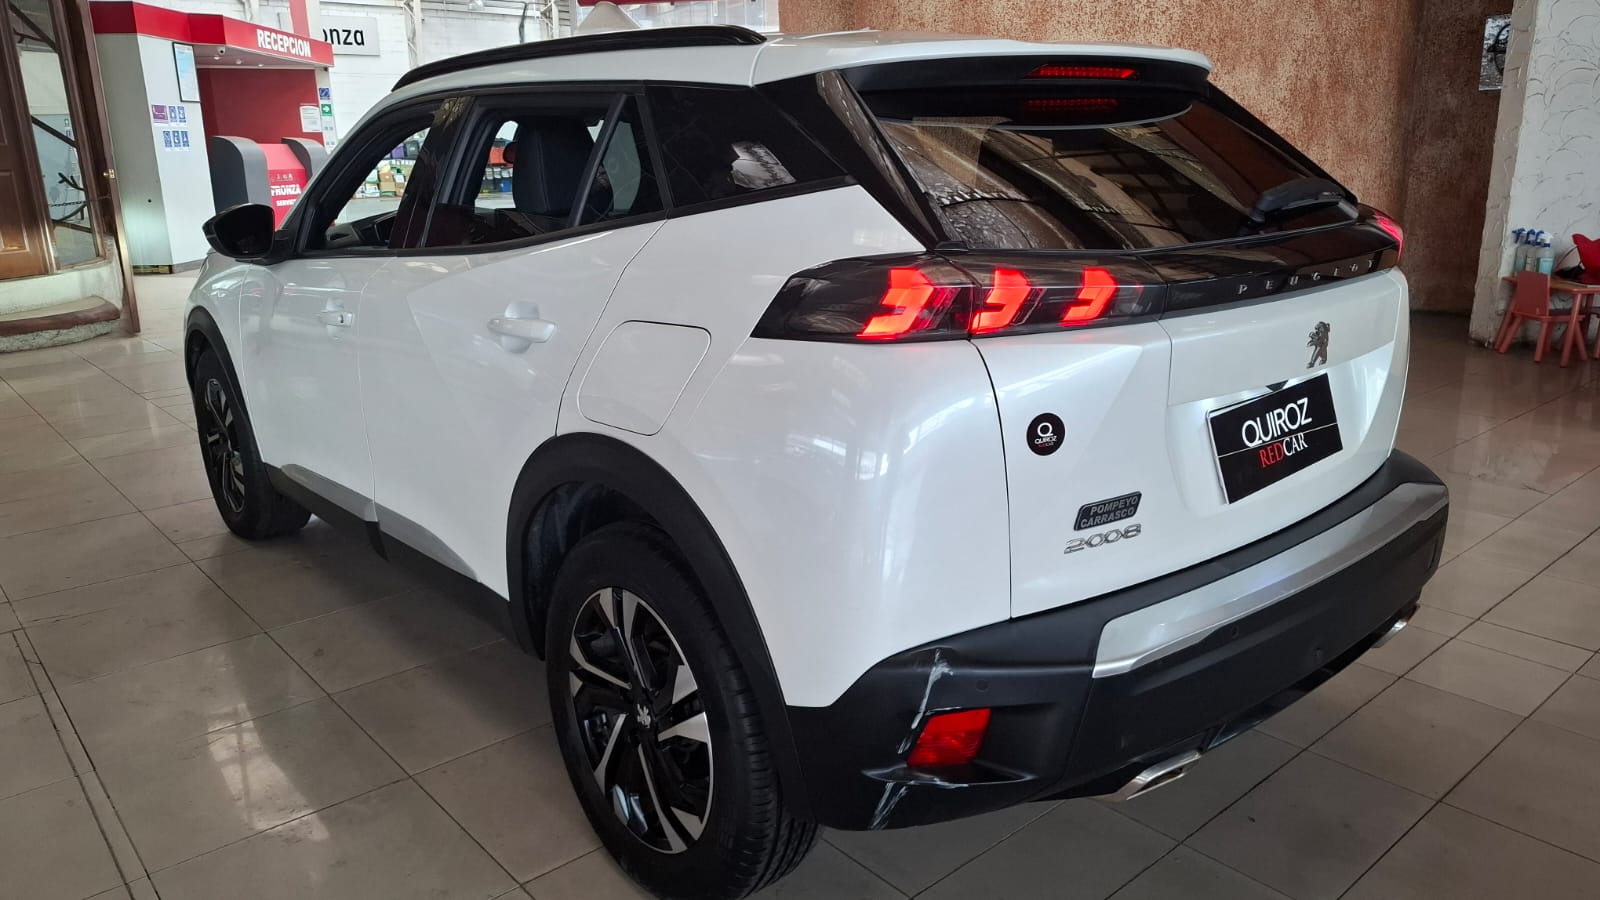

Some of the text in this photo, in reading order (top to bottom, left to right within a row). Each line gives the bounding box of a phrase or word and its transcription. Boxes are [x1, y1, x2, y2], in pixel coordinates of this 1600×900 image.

[256, 29, 311, 58] RECEPCION
[1037, 422, 1053, 437] Q
[1242, 397, 1312, 448] QUIROZ
[1259, 432, 1308, 468] REDCAR
[1080, 506, 1135, 528] CARRASCO
[1090, 495, 1138, 516] POMPEYO
[1063, 523, 1142, 554] 2008
